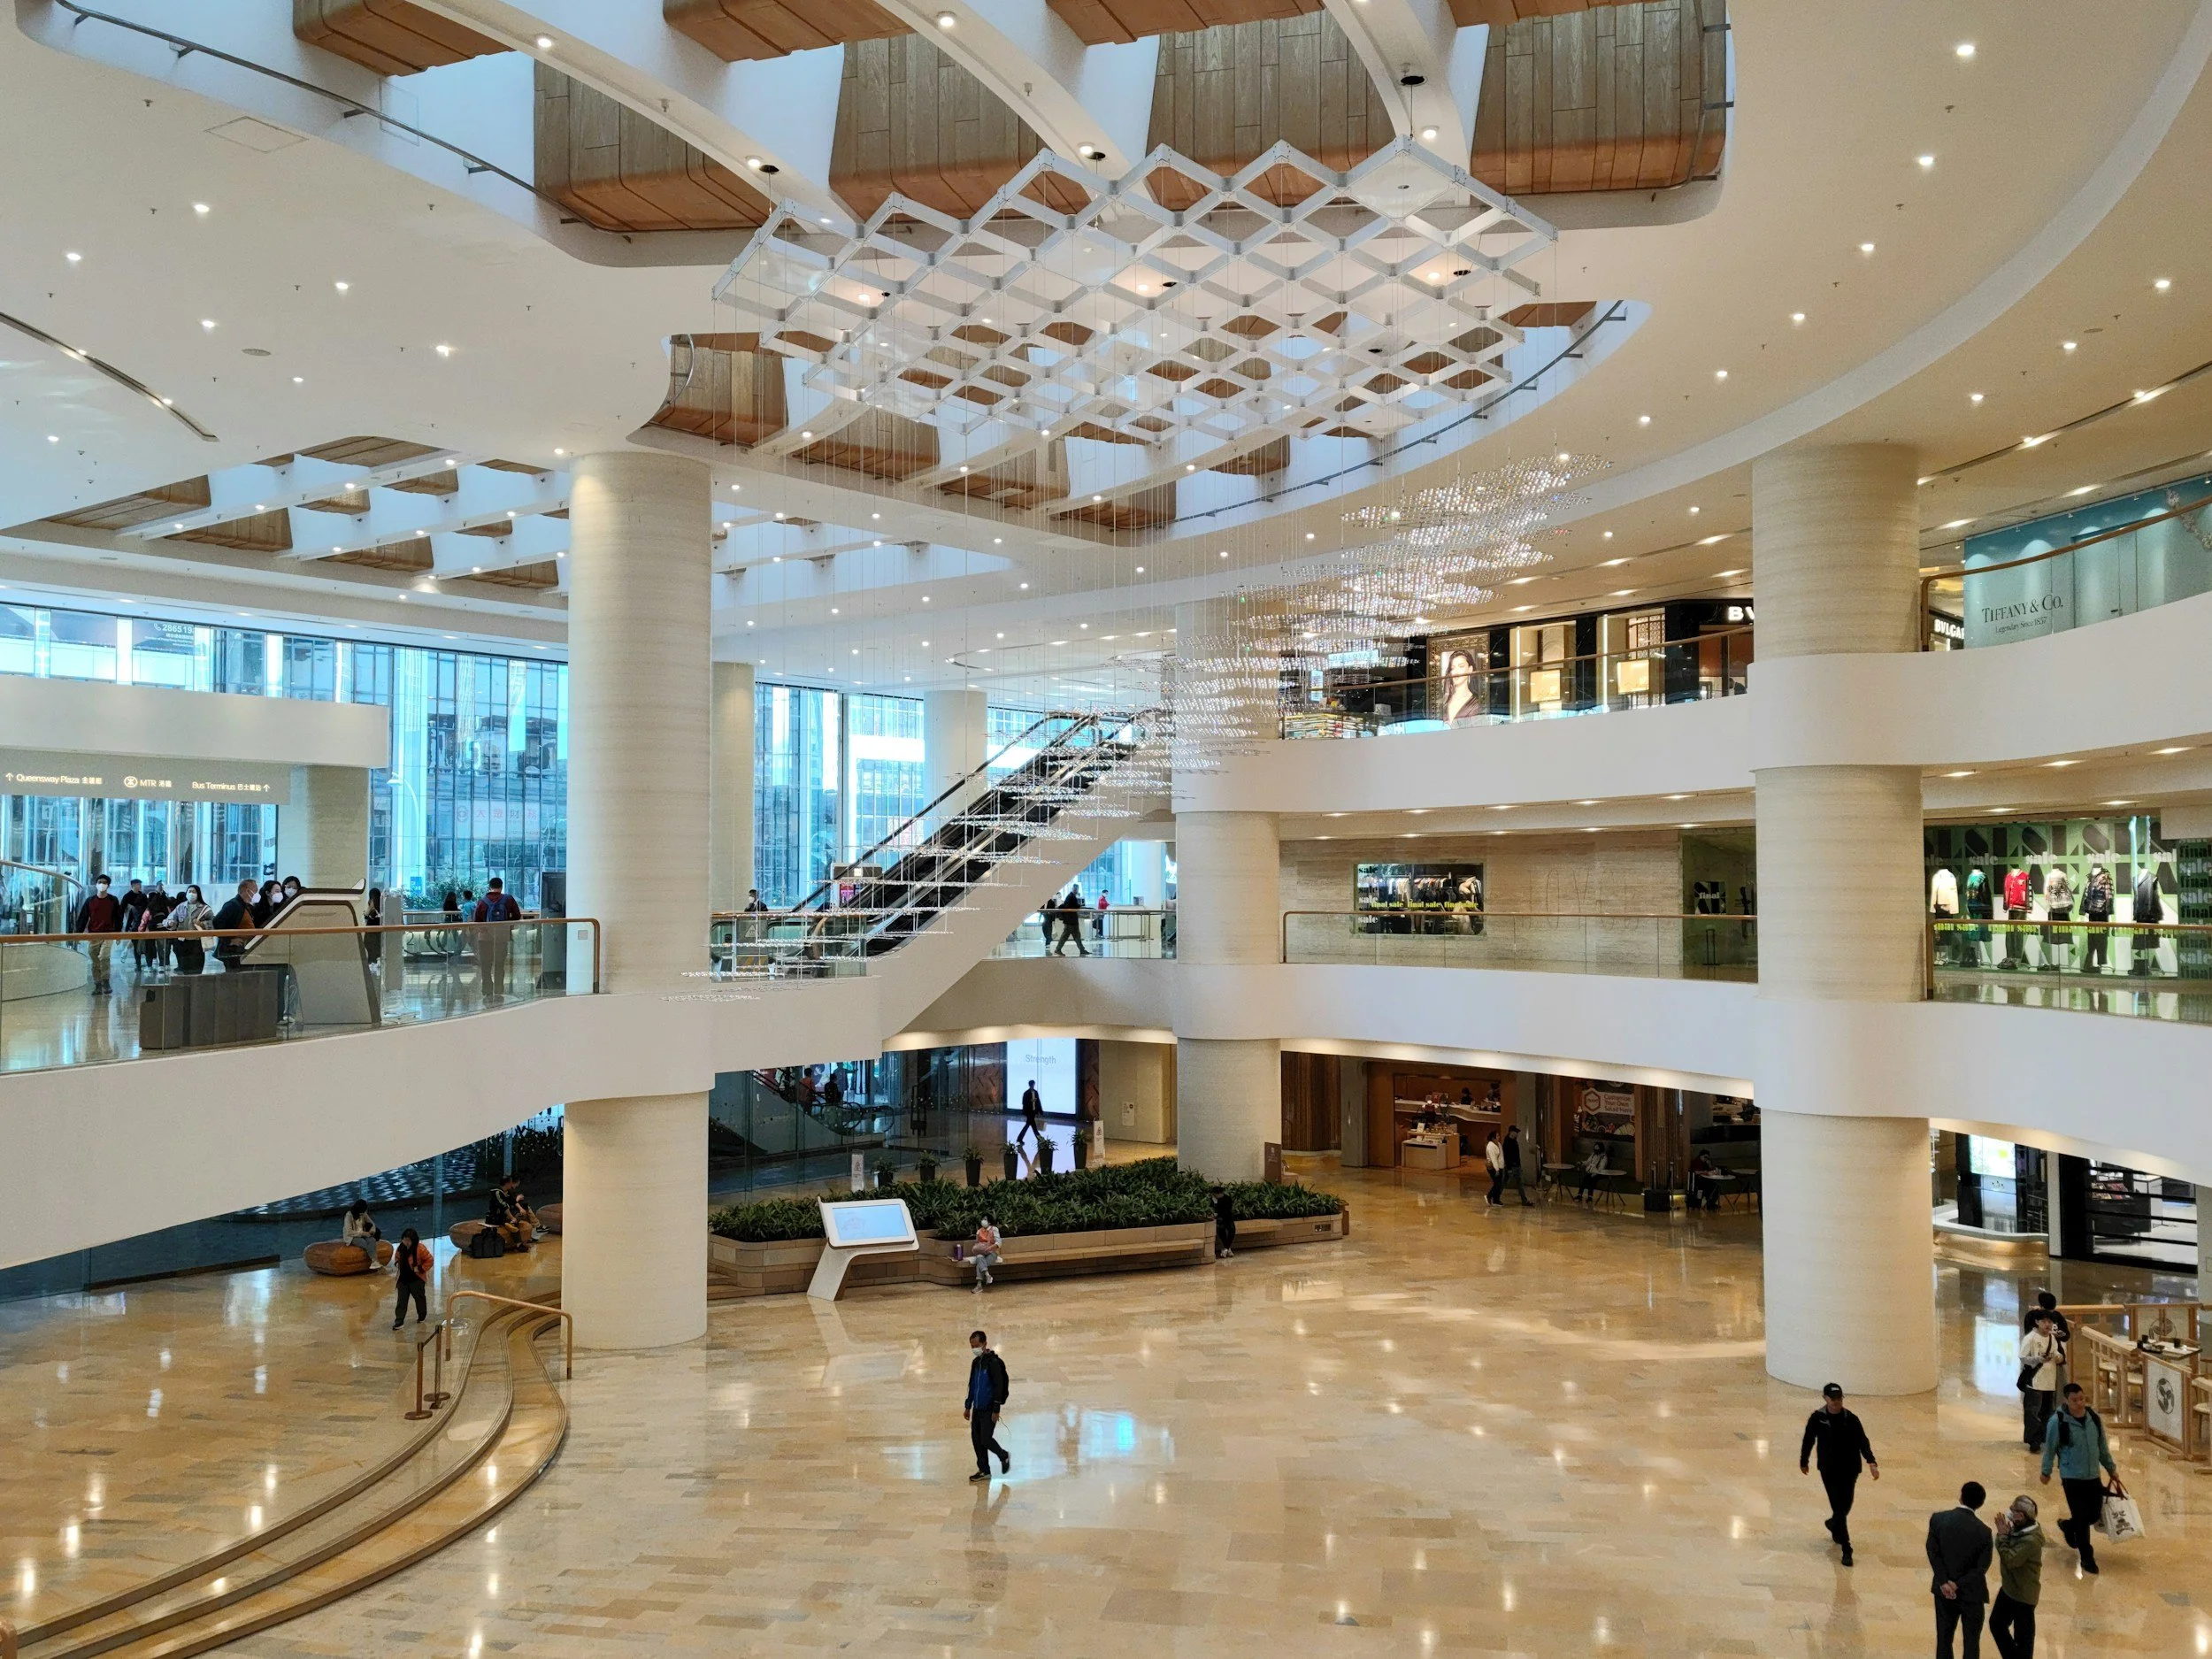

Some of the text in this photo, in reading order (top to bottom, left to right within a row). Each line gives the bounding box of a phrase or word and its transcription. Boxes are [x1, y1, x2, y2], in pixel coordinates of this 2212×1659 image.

[1982, 603, 2029, 623] TIFFANY
[2030, 600, 2039, 613] &
[16, 773, 59, 785] Queensway
[60, 775, 80, 784] Plaza
[140, 779, 157, 787] MTR
[206, 782, 235, 791] Terminus
[1969, 853, 1999, 865] sale
[2025, 851, 2058, 865] sale
[2086, 849, 2121, 864] sale
[1358, 895, 1378, 903] sale
[1358, 914, 1378, 923] sale
[1025, 1054, 1056, 1065] Strength
